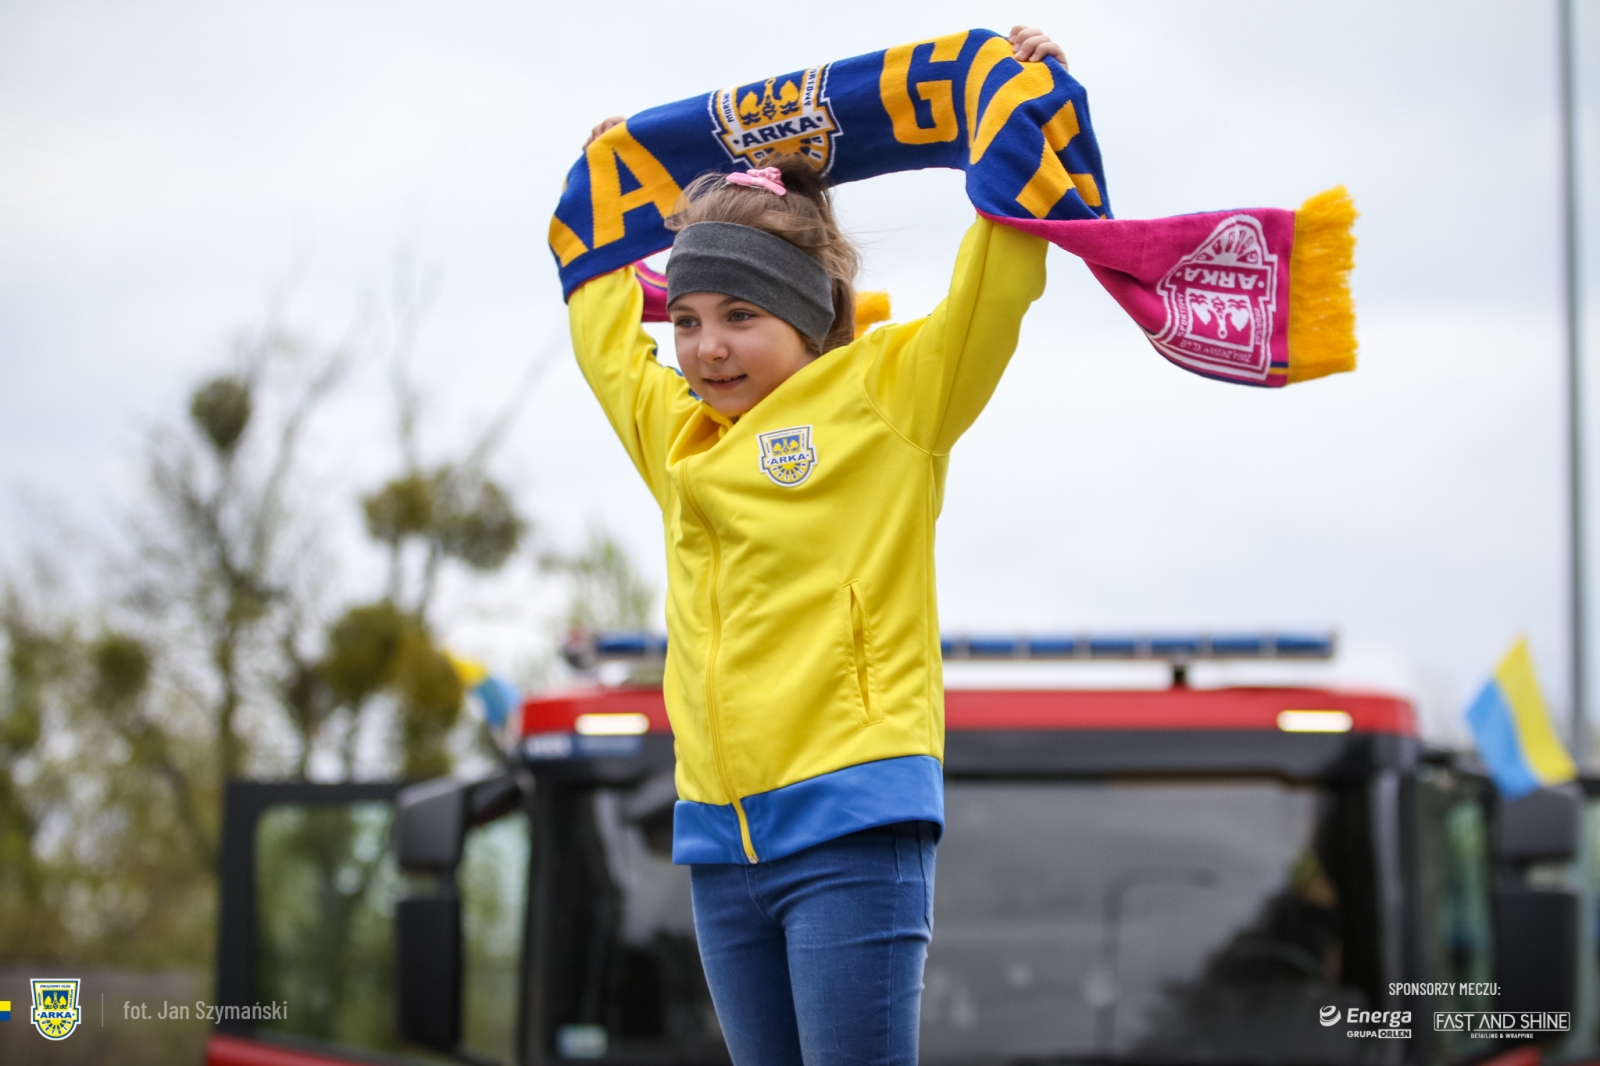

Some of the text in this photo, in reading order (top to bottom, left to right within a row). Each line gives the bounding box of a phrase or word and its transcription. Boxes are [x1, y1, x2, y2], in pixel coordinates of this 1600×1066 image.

[741, 116, 820, 148] ARKA
[1183, 267, 1261, 290] ARKA
[770, 453, 807, 465] ARKA
